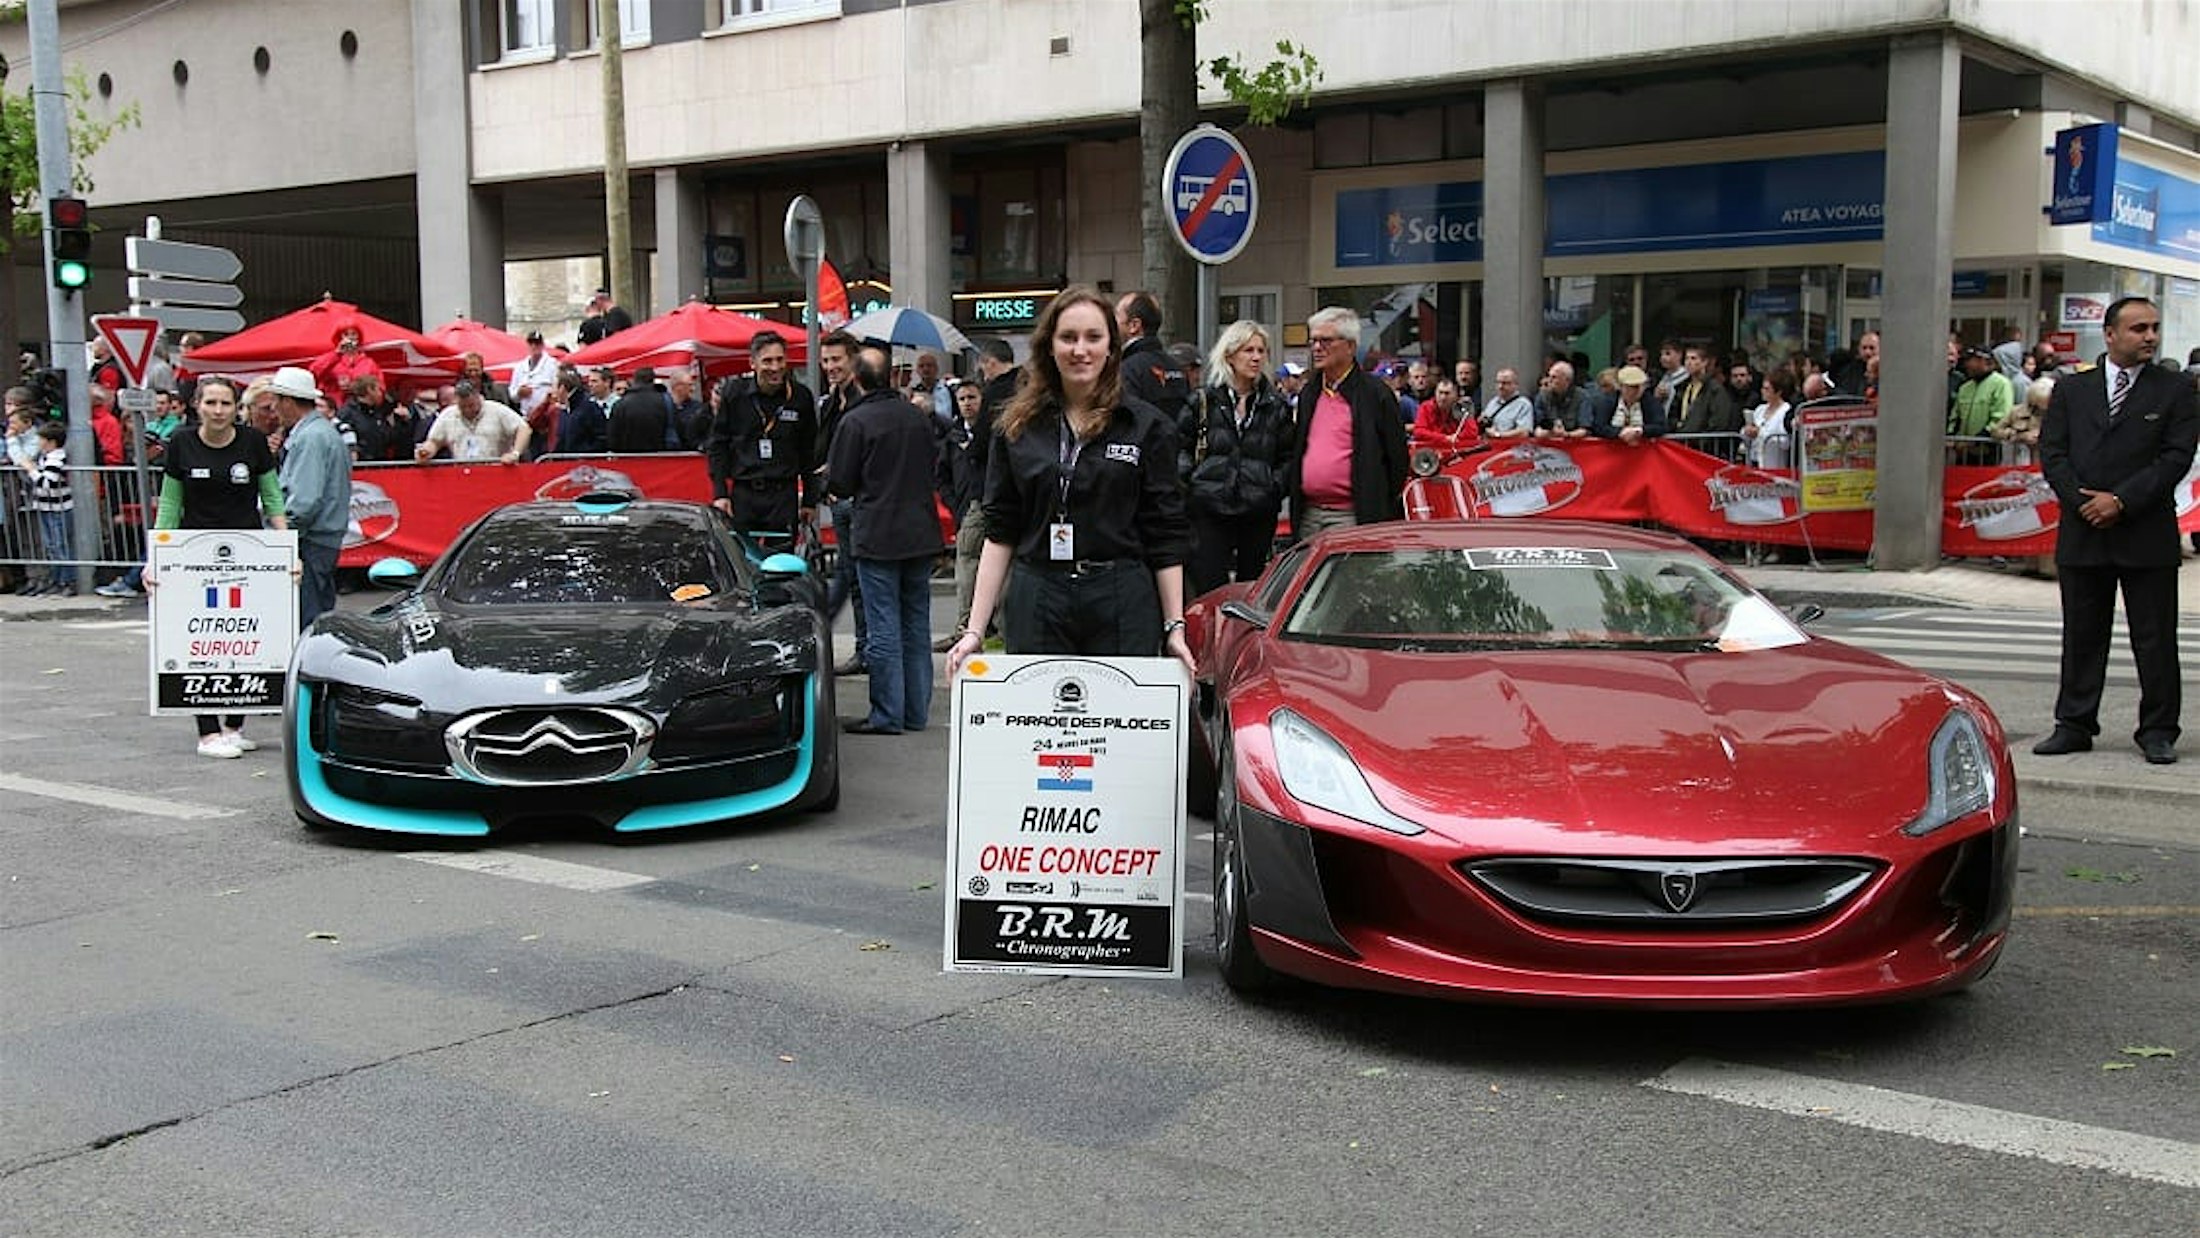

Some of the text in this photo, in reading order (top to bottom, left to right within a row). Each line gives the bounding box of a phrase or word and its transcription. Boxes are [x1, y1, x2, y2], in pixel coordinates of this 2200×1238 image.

[1781, 207, 1821, 223] ATEA
[975, 299, 1035, 320] PRESSE
[188, 617, 259, 633] CITROEN
[190, 640, 261, 656] SURVOLT
[1005, 715, 1068, 728] PARADE
[1070, 717, 1102, 729] DES
[1103, 718, 1171, 730] PILOTES
[1032, 738, 1053, 752] 24
[1021, 806, 1101, 834] RIMAC
[979, 845, 1161, 875] ONE CONCEPT
